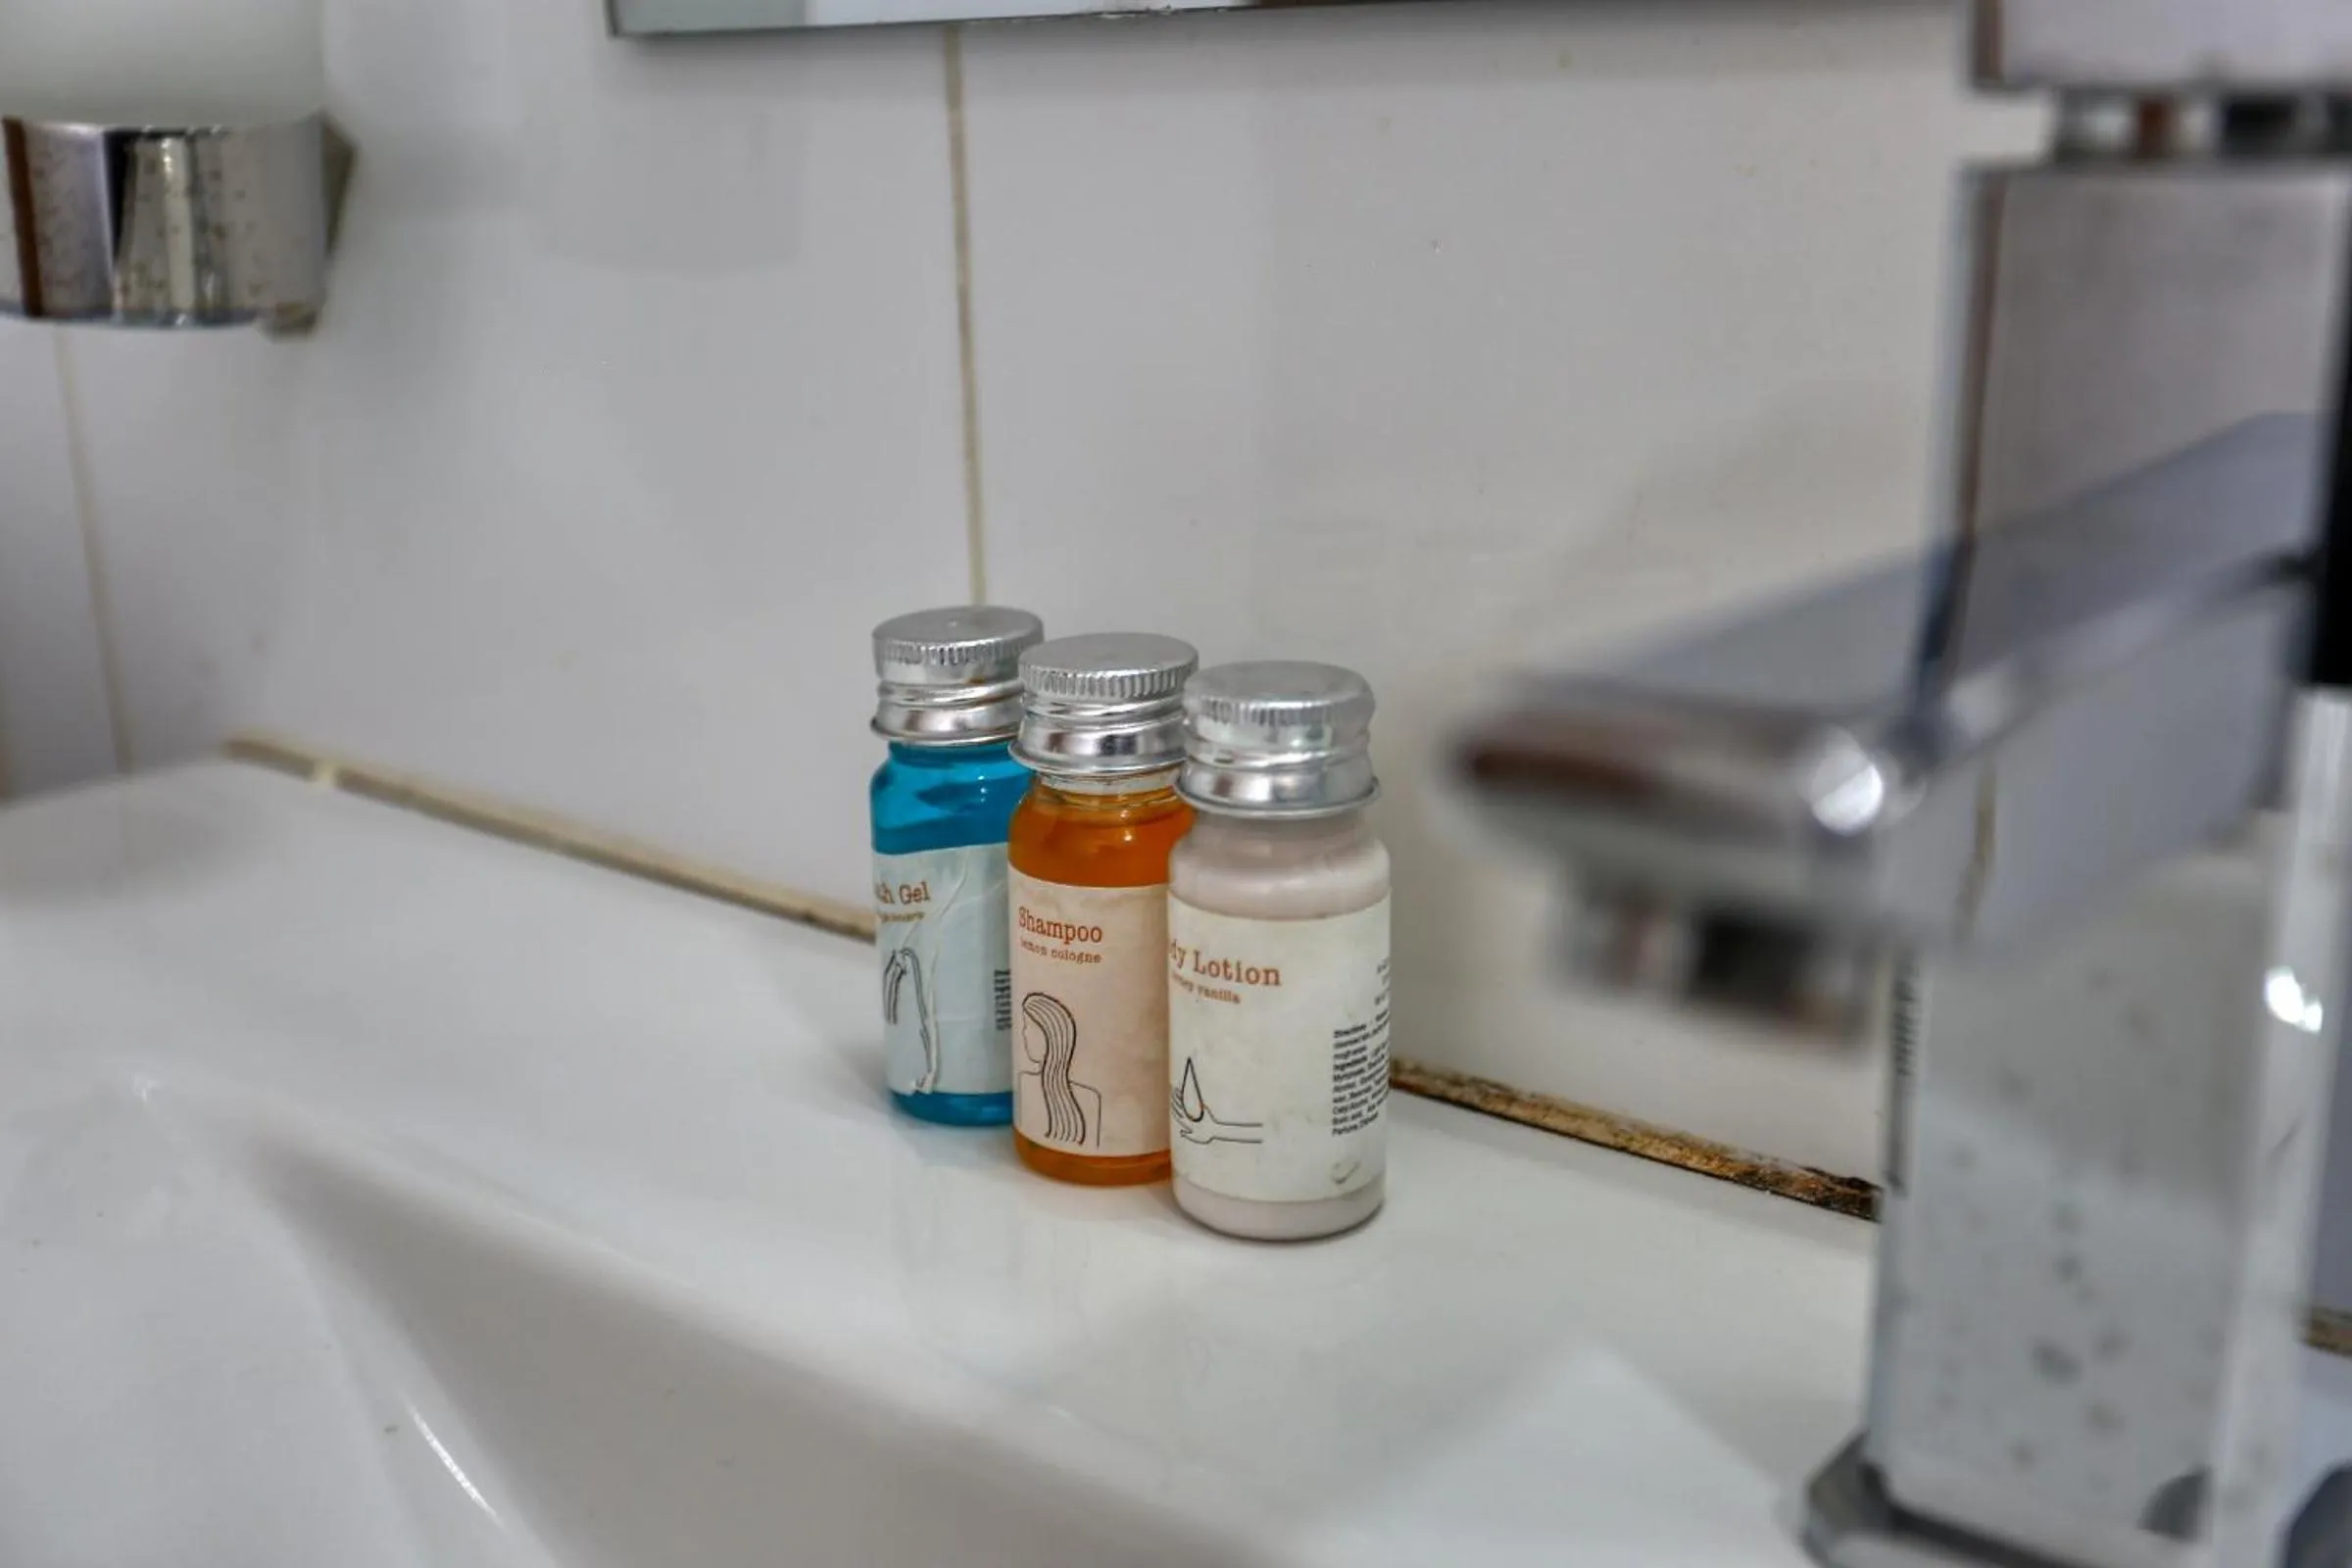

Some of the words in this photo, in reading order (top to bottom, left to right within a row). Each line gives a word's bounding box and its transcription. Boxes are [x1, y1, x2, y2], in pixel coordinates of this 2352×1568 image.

[899, 879, 930, 906] Gel
[1018, 906, 1102, 945] Shampoo
[1193, 949, 1282, 987] Lotion
